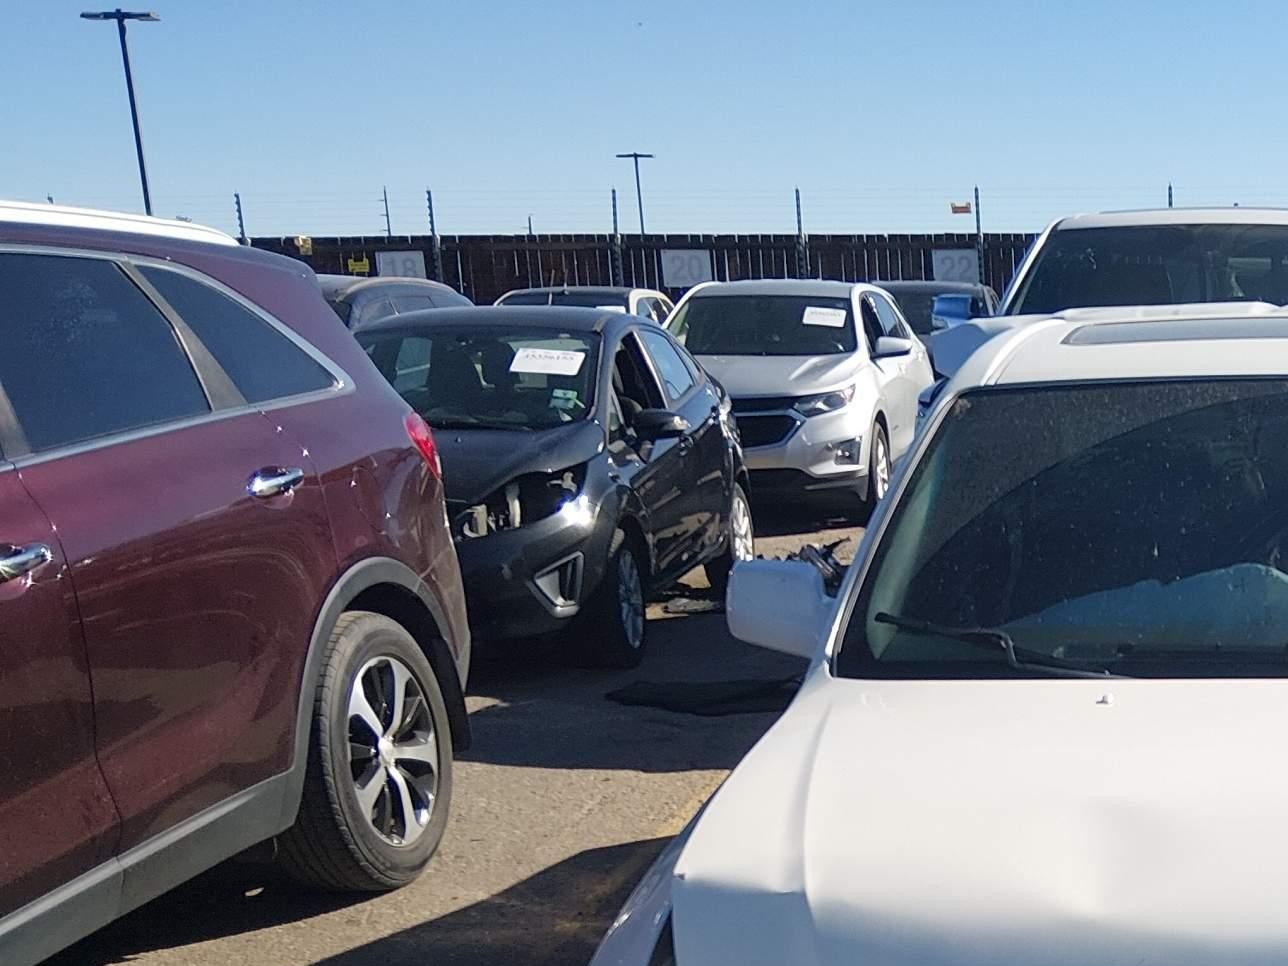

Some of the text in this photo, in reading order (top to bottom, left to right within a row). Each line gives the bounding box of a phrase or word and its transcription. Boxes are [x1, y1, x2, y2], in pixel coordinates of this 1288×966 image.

[385, 256, 419, 277] 18
[671, 254, 704, 281] 20
[941, 254, 973, 282] 22
